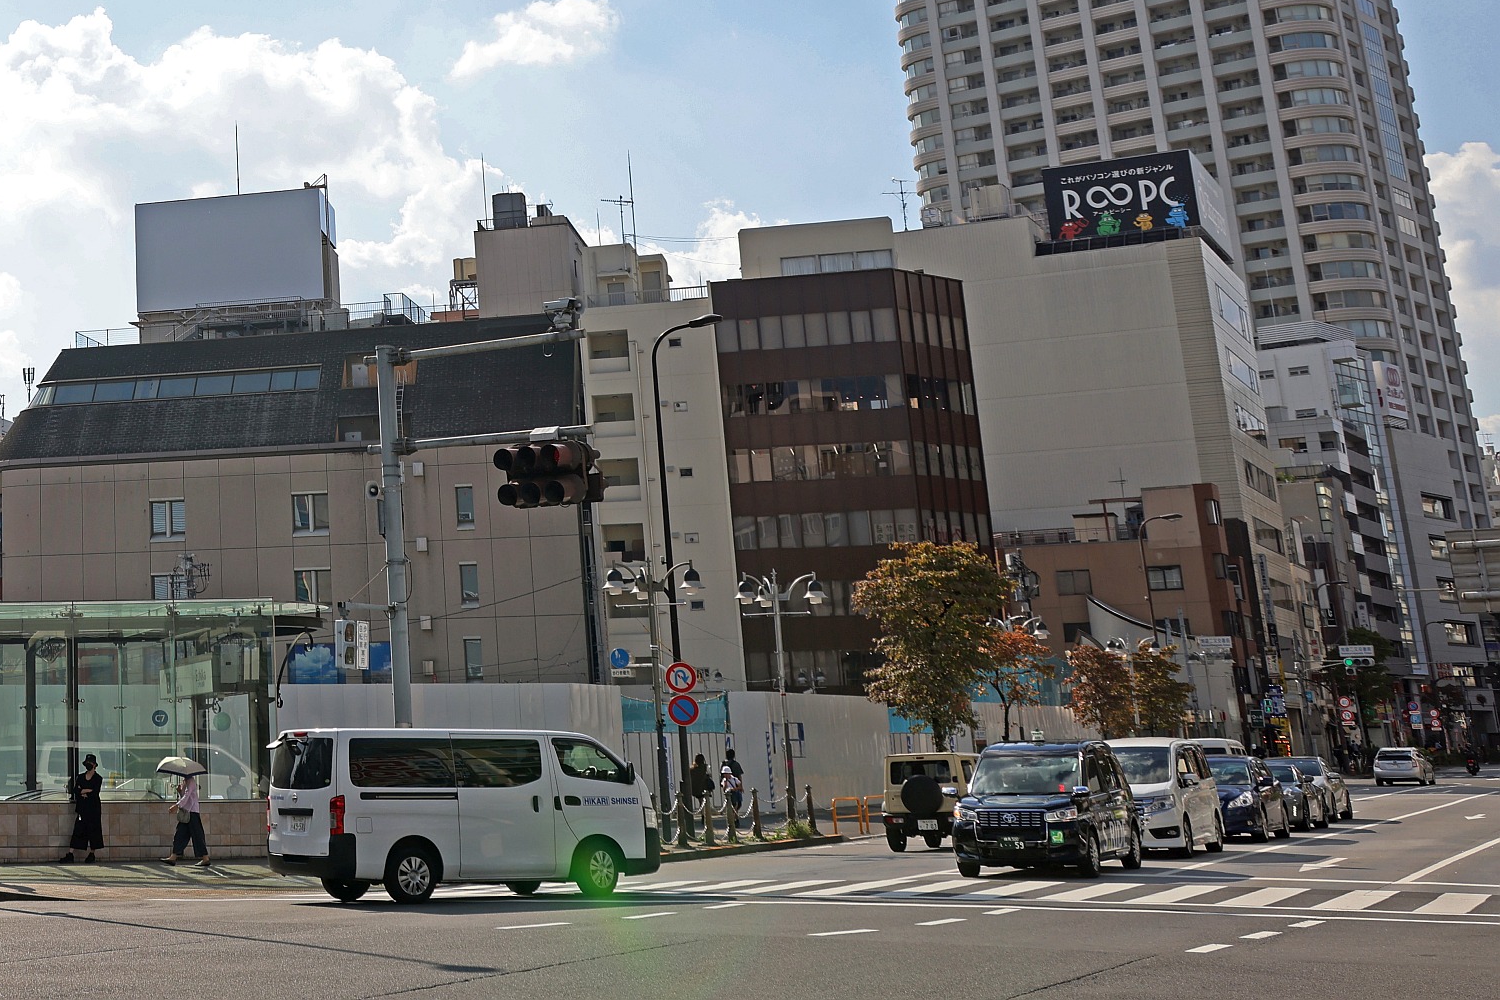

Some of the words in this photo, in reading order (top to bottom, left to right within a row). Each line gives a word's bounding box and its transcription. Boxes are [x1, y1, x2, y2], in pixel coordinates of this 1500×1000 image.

[1060, 163, 1174, 185] これがパソコン選びの新ジャンル
[155, 714, 165, 722] C7
[584, 797, 609, 805] HIKARI
[610, 797, 639, 805] SHINSEI
